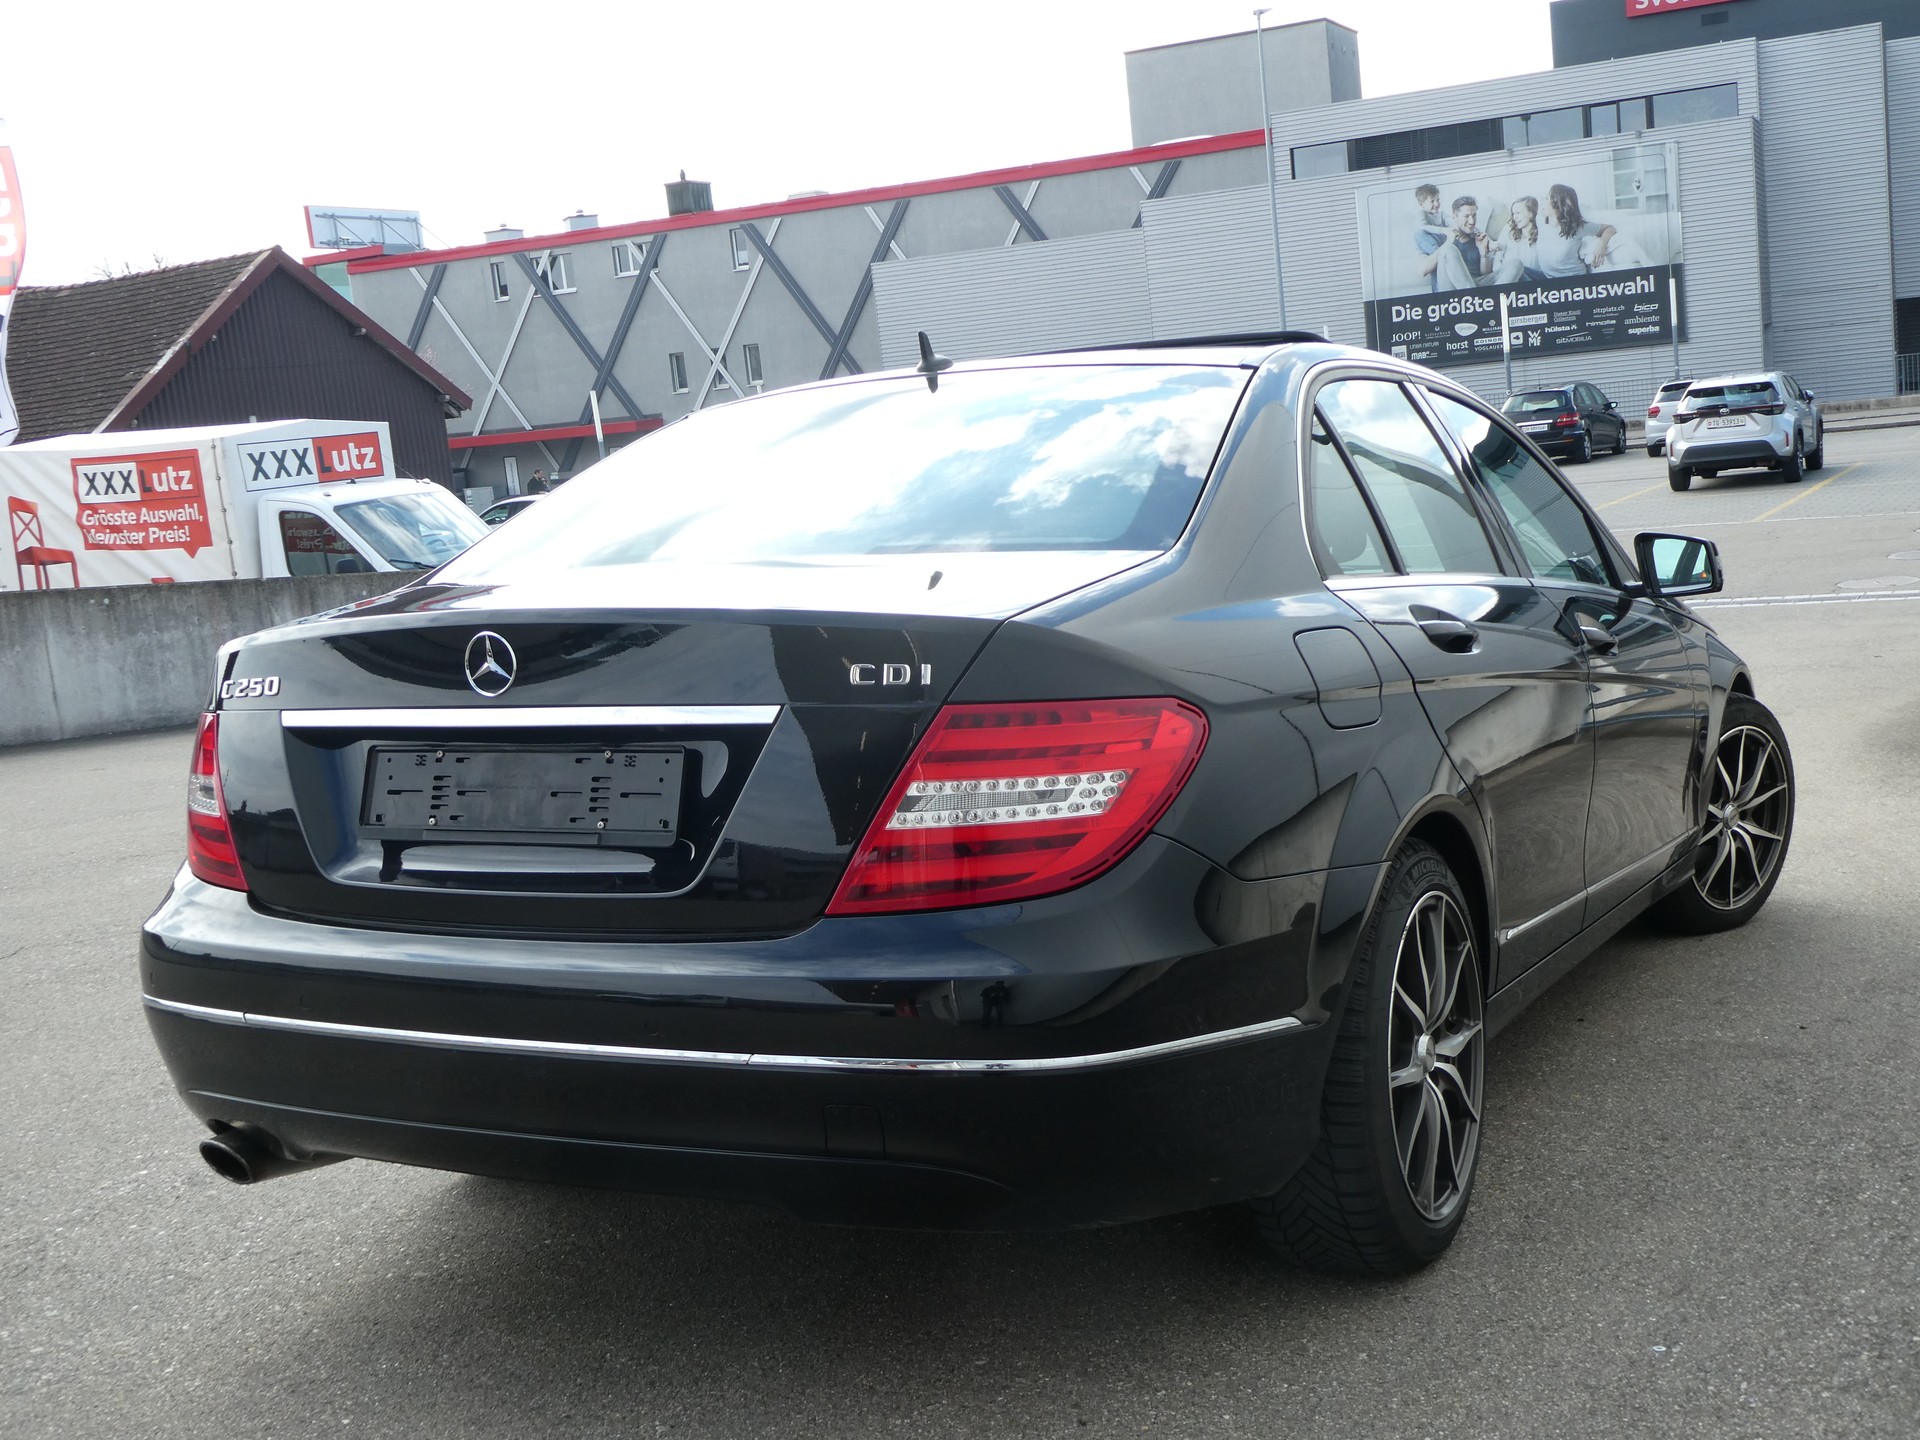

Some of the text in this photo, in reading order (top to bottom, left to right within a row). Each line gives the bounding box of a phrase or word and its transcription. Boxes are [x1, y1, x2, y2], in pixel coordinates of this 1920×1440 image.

[1391, 274, 1655, 322] Die größte Markenauswahl
[1592, 305, 1625, 314] sitzplatz.ch
[1633, 303, 1659, 312] bico
[1510, 315, 1546, 325] girsberger
[1624, 315, 1660, 325] ambiente
[1628, 325, 1660, 335] superba
[1391, 331, 1421, 343] JOOP!
[1446, 340, 1468, 351] horst
[82, 503, 203, 526] Grösste Auswahl,
[149, 525, 191, 543] Preis!
[850, 663, 931, 685] CDI
[1411, 859, 1446, 882] MICHELIN
